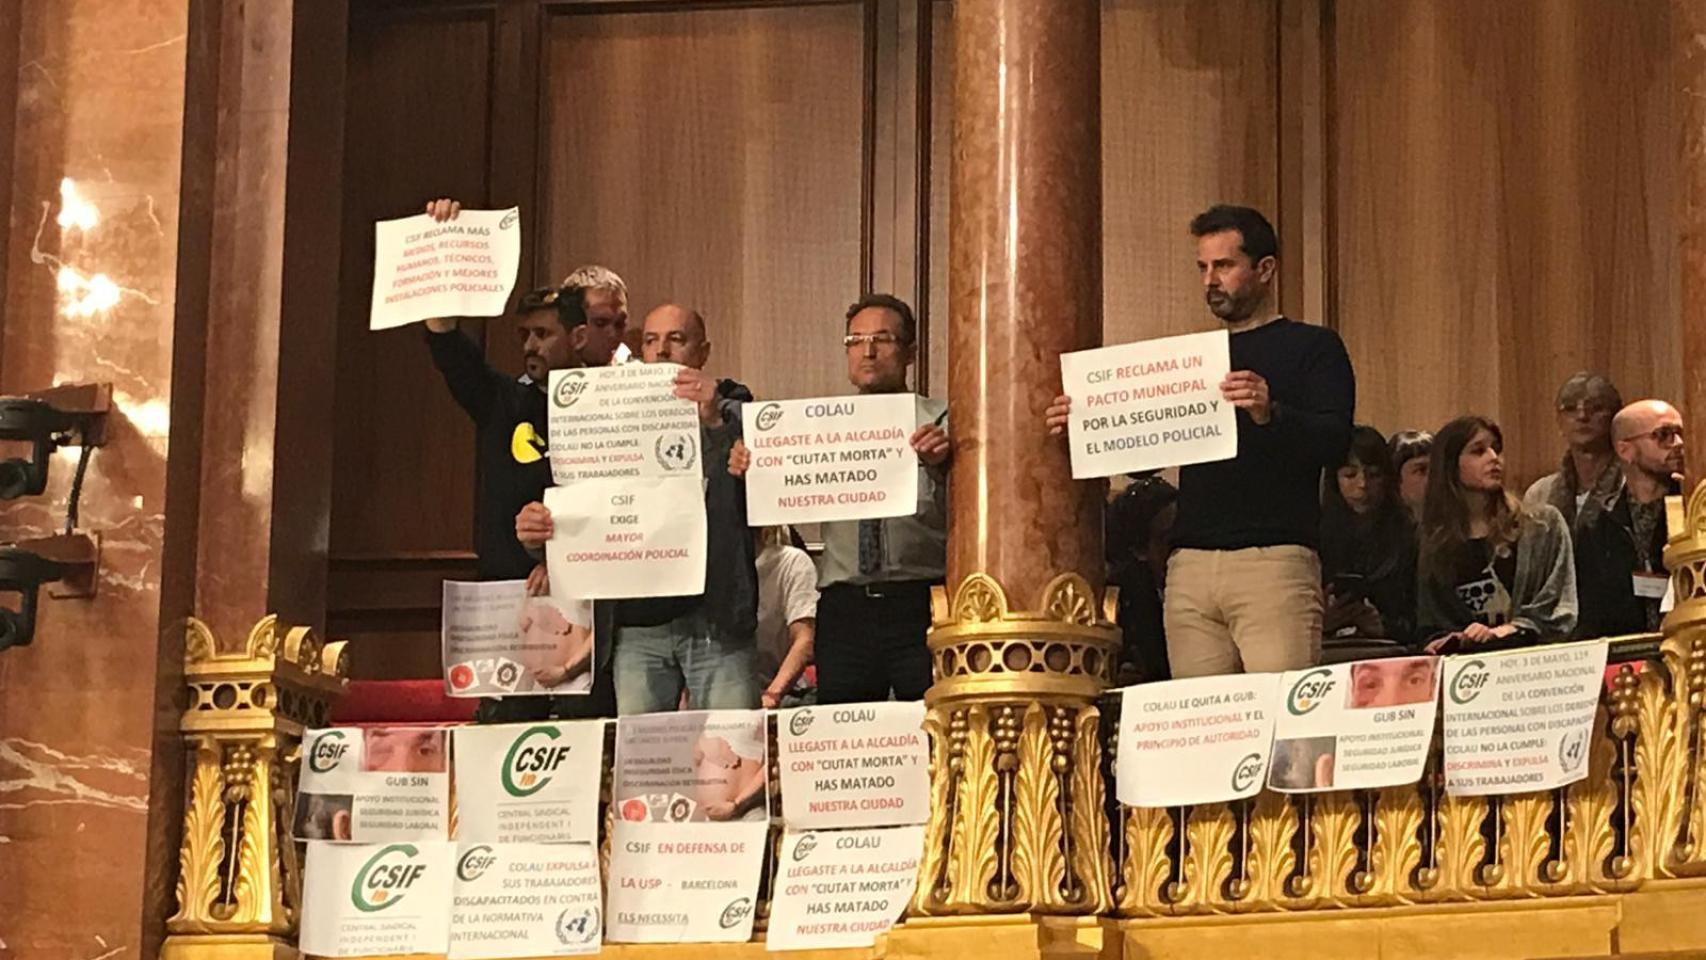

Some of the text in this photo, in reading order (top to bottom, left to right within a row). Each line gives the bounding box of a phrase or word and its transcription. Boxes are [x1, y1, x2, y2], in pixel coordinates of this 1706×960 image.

[467, 226, 490, 236] MÁS
[439, 241, 489, 249] RECURSOS
[452, 269, 498, 278] MEJORES
[450, 283, 504, 292] POLICIALES
[1086, 355, 1203, 384] CSIF RECLAMA UN
[1087, 379, 1207, 407] PACTO MUNICIPAL
[600, 399, 609, 407] DE
[805, 403, 855, 418] COLAU
[1082, 400, 1219, 431] POR LA SEGURIDAD Y
[564, 428, 577, 436] LAS
[579, 424, 620, 435] PERSONAS
[622, 424, 639, 433] CON
[754, 427, 904, 448] LLEGASTE A LA ALCALDÍA
[1086, 425, 1222, 455] EL MODELO POLICIAL
[581, 441, 593, 450] NO
[595, 440, 604, 448] LA
[602, 454, 644, 463] Y EXPULSA
[756, 456, 782, 467] CON
[896, 448, 903, 458] Y
[578, 468, 640, 478] TRABAJADORES
[784, 469, 877, 486] HAS MATADO
[611, 496, 635, 505] CSIF
[778, 491, 886, 508] NUESTRA CIUDAD
[610, 515, 638, 524] EXIGE
[605, 533, 643, 542] MAYOR
[567, 549, 689, 562] COORDINACIÓN POLICIAL
[1530, 657, 1541, 665] DE
[1496, 666, 1596, 685] ANIVERSARIO NACIONAL
[1502, 684, 1584, 701] DE LA CONVENCIÓN
[1143, 694, 1231, 712] COLAU LE QUITA A
[833, 710, 876, 723] COLAU
[1374, 710, 1415, 723] GUB SIN
[1446, 702, 1564, 722] INTERNACIONAL SOBRE LOS
[1134, 710, 1264, 732] APOYO INSTITUCIONAL Y EL
[1446, 721, 1546, 738] DE LAS PERSONAS CON
[789, 734, 919, 753] LLEGASTE A LA ALCALDÍA
[1136, 729, 1260, 751] PRINCIPIO DE AUTORIDAD
[1447, 740, 1509, 755] COLAU NO LA
[791, 761, 814, 772] CON
[911, 755, 918, 765] Y
[1505, 758, 1510, 766] Y
[1512, 756, 1549, 766] EXPULSA
[411, 777, 429, 786] SIN
[815, 776, 895, 791] HAS MATADO
[1457, 776, 1474, 786] SUS
[1476, 773, 1544, 785] TRABAJADORES
[809, 797, 904, 812] NUESTRA CIUDAD
[626, 841, 745, 853] CSIF EN DEFENSA DE
[836, 836, 881, 849] COLAU
[509, 861, 589, 872] COLAU EXPULSA
[787, 858, 917, 878] LLEGASTE A LA ALCALDÍA
[502, 877, 597, 888] SUS TRABAJADORES
[621, 877, 636, 888] LA
[639, 878, 662, 889] USP
[681, 880, 738, 890] BARCELONA
[785, 885, 808, 895] CON
[906, 878, 912, 887] Y
[454, 893, 598, 906] DISCAPACITADOS EN CONTRA
[806, 899, 889, 914] HAS MATADO
[452, 913, 543, 924] DE LA NORMATIVA
[618, 912, 689, 925] ELS NECESSITA
[797, 919, 890, 935] NUESTRA CIUDAD
[450, 930, 528, 941] INTERNACIONAL
